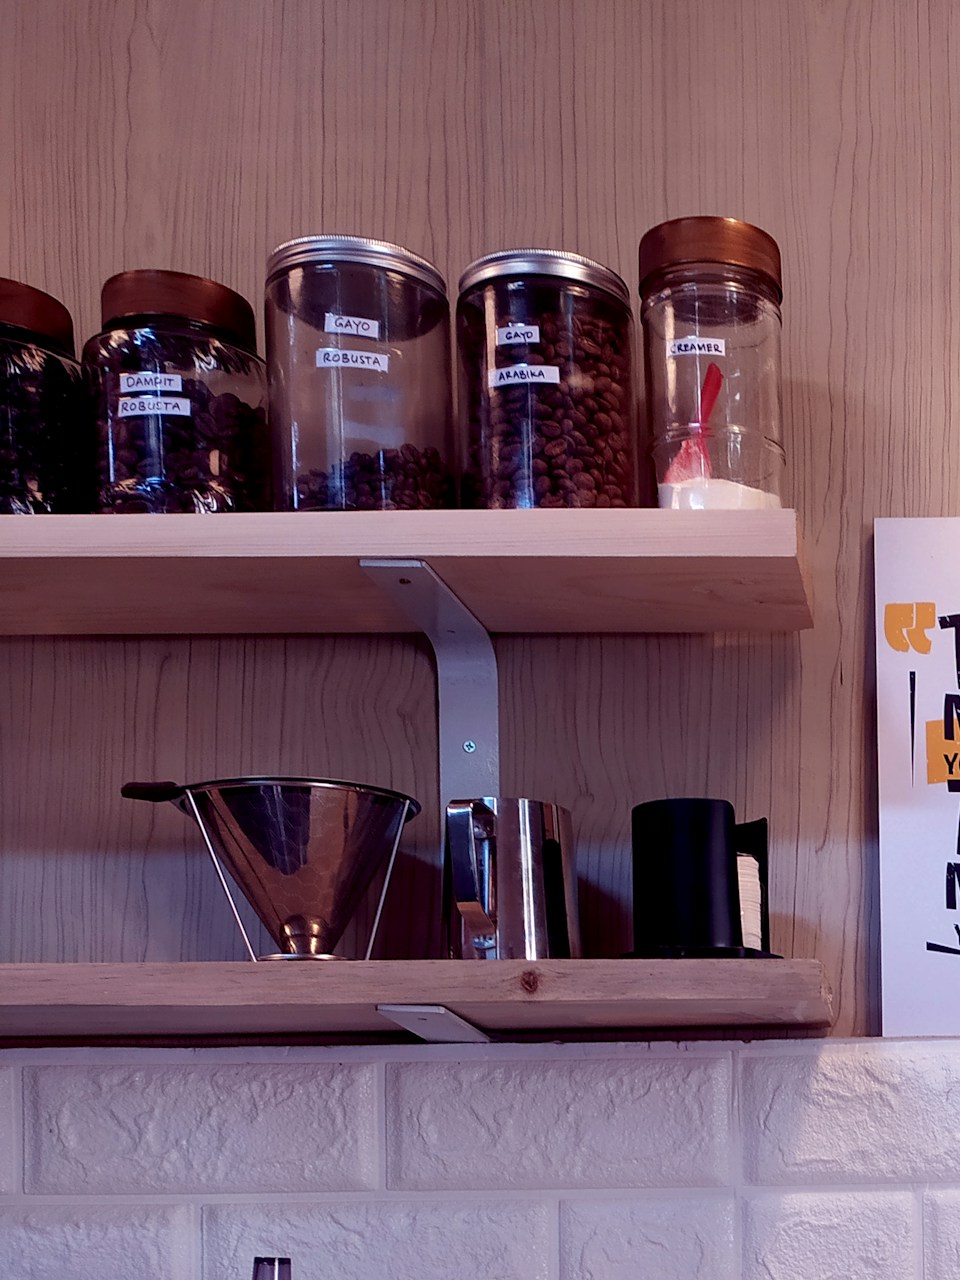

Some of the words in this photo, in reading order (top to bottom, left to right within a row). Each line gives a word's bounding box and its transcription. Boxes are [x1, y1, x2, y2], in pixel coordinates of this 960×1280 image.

[334, 317, 371, 333] GAYO
[505, 331, 534, 342] GAYO
[670, 342, 723, 354] CREAMER
[322, 352, 380, 366] ROBUSTA
[498, 369, 546, 380] ARABIKA
[121, 401, 181, 413] ROBUSTA
